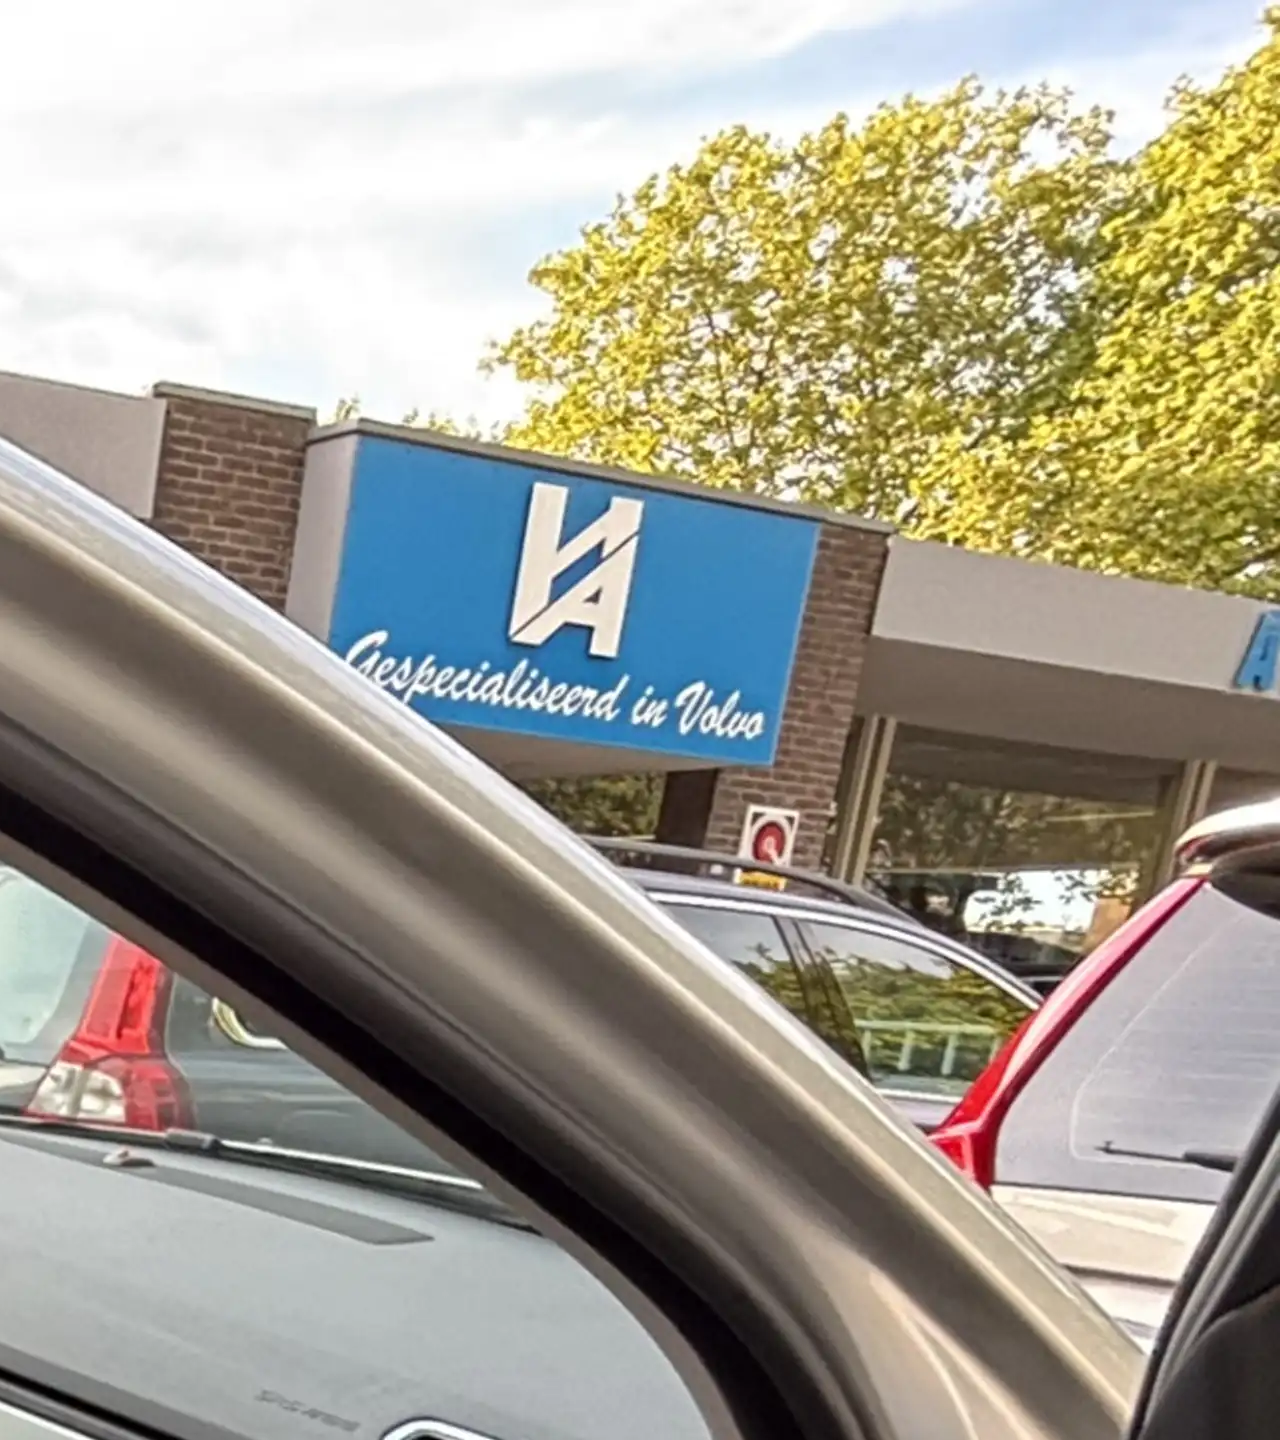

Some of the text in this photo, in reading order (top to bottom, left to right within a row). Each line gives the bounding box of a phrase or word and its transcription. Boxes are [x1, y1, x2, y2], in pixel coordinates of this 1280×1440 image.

[345, 630, 765, 741] Gespecialiseerd in Volvo
